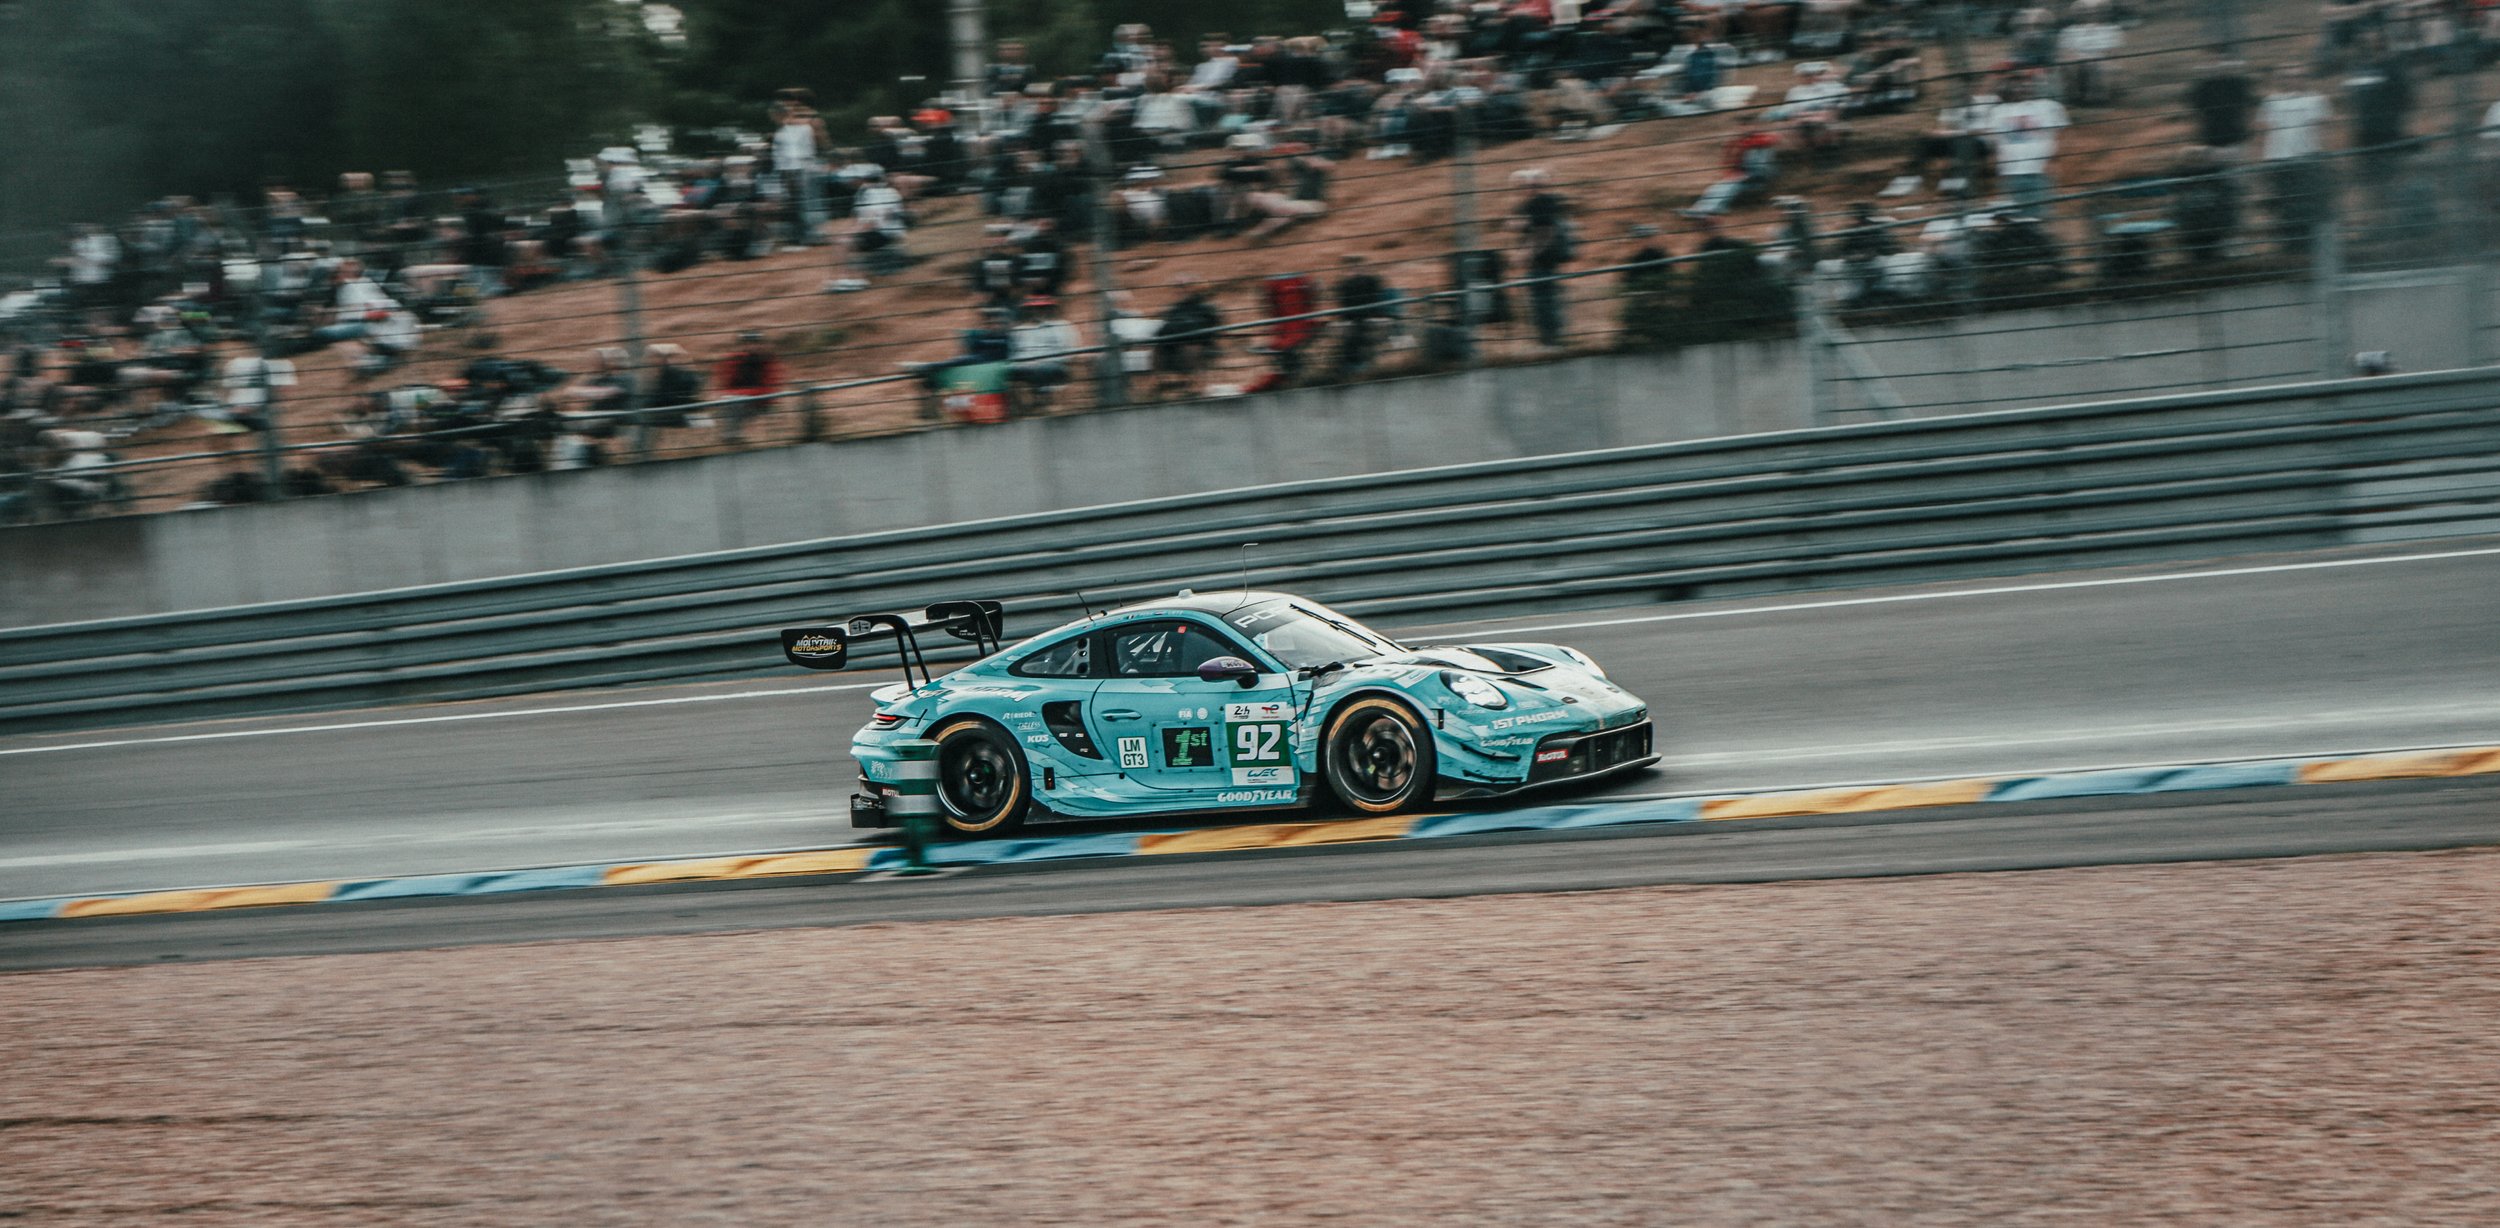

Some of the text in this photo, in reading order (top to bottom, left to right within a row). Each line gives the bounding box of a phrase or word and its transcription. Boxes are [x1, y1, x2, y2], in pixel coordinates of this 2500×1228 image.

[792, 644, 842, 652] MOTORSPORTS
[1491, 710, 1569, 730] 1ST PHORM
[1123, 739, 1141, 752] LM
[1172, 730, 1208, 766] 1st
[1237, 724, 1281, 761] 92
[1480, 736, 1535, 748] GOODYEAR
[1123, 753, 1146, 767] GT3
[1247, 768, 1280, 778] WEC
[1217, 788, 1293, 803] GOODYEAR
